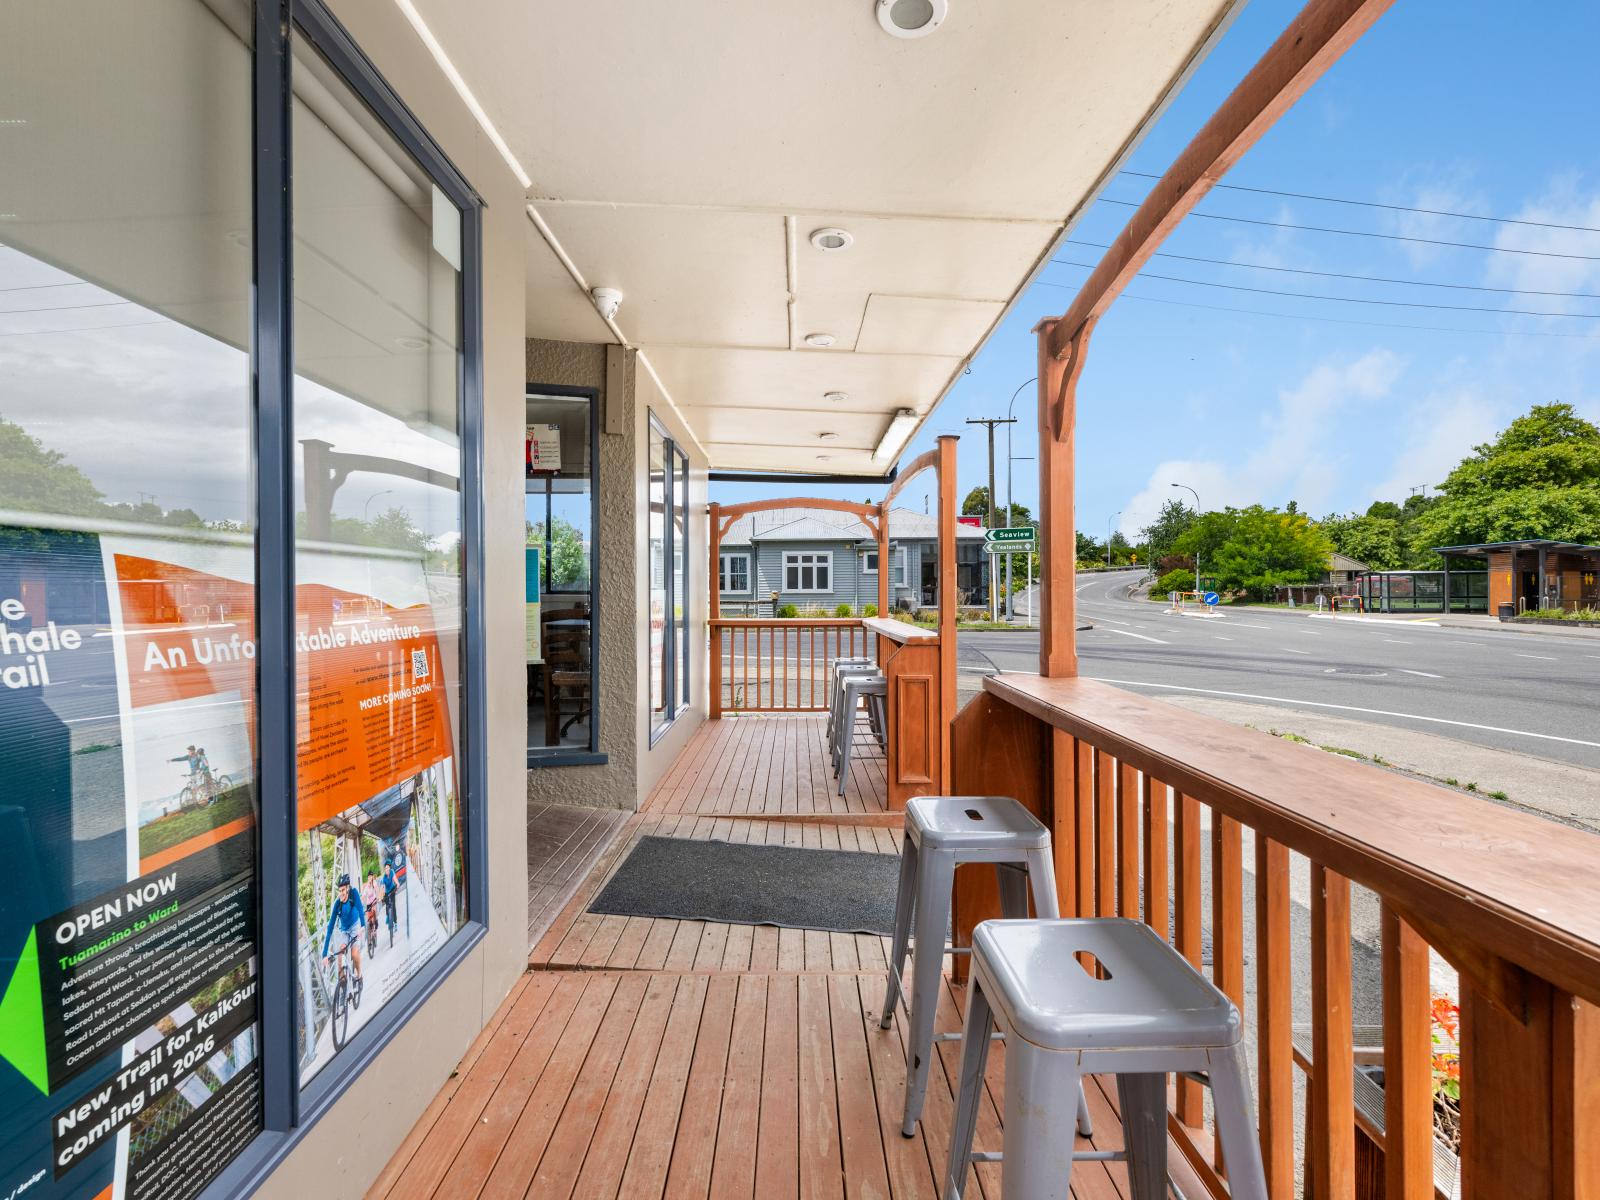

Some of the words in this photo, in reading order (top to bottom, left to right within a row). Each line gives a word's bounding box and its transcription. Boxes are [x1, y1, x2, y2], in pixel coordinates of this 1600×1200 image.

[0, 620, 82, 654] hale
[0, 654, 50, 688] ail
[144, 641, 188, 671] An
[350, 624, 420, 646] Adventure
[359, 695, 382, 711] MORE
[382, 688, 412, 703] COMING
[412, 683, 432, 696] SOON!
[55, 898, 122, 944] OPEN
[126, 872, 177, 912] NOW
[59, 929, 131, 970] Tuamarino
[133, 920, 147, 933] to
[148, 901, 179, 924] Ward
[60, 962, 103, 991] Adventure
[105, 946, 133, 968] through
[134, 922, 177, 951] breathtaking
[177, 904, 210, 927] landscapes
[62, 986, 86, 1007] lakes,
[87, 963, 127, 993] vineyards,
[128, 955, 141, 968] and
[142, 948, 154, 960] the
[154, 929, 188, 954] welcoming
[189, 919, 206, 933] towns
[206, 915, 212, 923] of
[63, 997, 94, 1021] Seddon
[95, 988, 110, 1002] and
[111, 974, 134, 992] Ward.
[135, 965, 150, 978] Your
[151, 950, 175, 970] journey
[176, 943, 186, 953] will
[187, 938, 195, 947] be
[196, 919, 226, 942] overlooked
[226, 915, 233, 925] by
[233, 910, 242, 919] the
[64, 1014, 92, 1036] sacred
[94, 1006, 105, 1018] Mt
[170, 959, 182, 971] and
[183, 950, 197, 963] from
[198, 939, 213, 953] south
[214, 935, 220, 944] of
[220, 929, 230, 939] the
[66, 1032, 87, 1051] Road
[88, 1011, 120, 1036] Lookout
[121, 1006, 129, 1016] at
[130, 988, 156, 1010] Seddon
[174, 966, 191, 982] enjoy
[191, 955, 208, 970] views
[208, 952, 214, 960] to
[215, 945, 224, 955] the
[66, 1043, 94, 1067] Ocean
[95, 1032, 110, 1048] and
[111, 1023, 124, 1037] the
[125, 1006, 151, 1028] chance
[152, 1000, 159, 1010] to
[160, 991, 175, 1006] spot
[175, 974, 200, 995] dolphins
[208, 952, 233, 974] migrating
[57, 1086, 113, 1138] New
[116, 1046, 163, 1091] Trail
[166, 1028, 192, 1057] for
[197, 980, 257, 1034] Kaikōur
[57, 1091, 145, 1166] coming
[149, 1074, 169, 1097] in
[172, 1034, 215, 1079] 2026
[216, 1120, 226, 1132] and
[16, 1168, 47, 1194] design
[134, 1159, 170, 1195] community
[136, 1158, 155, 1180] Thank
[157, 1148, 168, 1162] you
[170, 1141, 176, 1149] to
[178, 1131, 187, 1142] the
[189, 1117, 204, 1133] many
